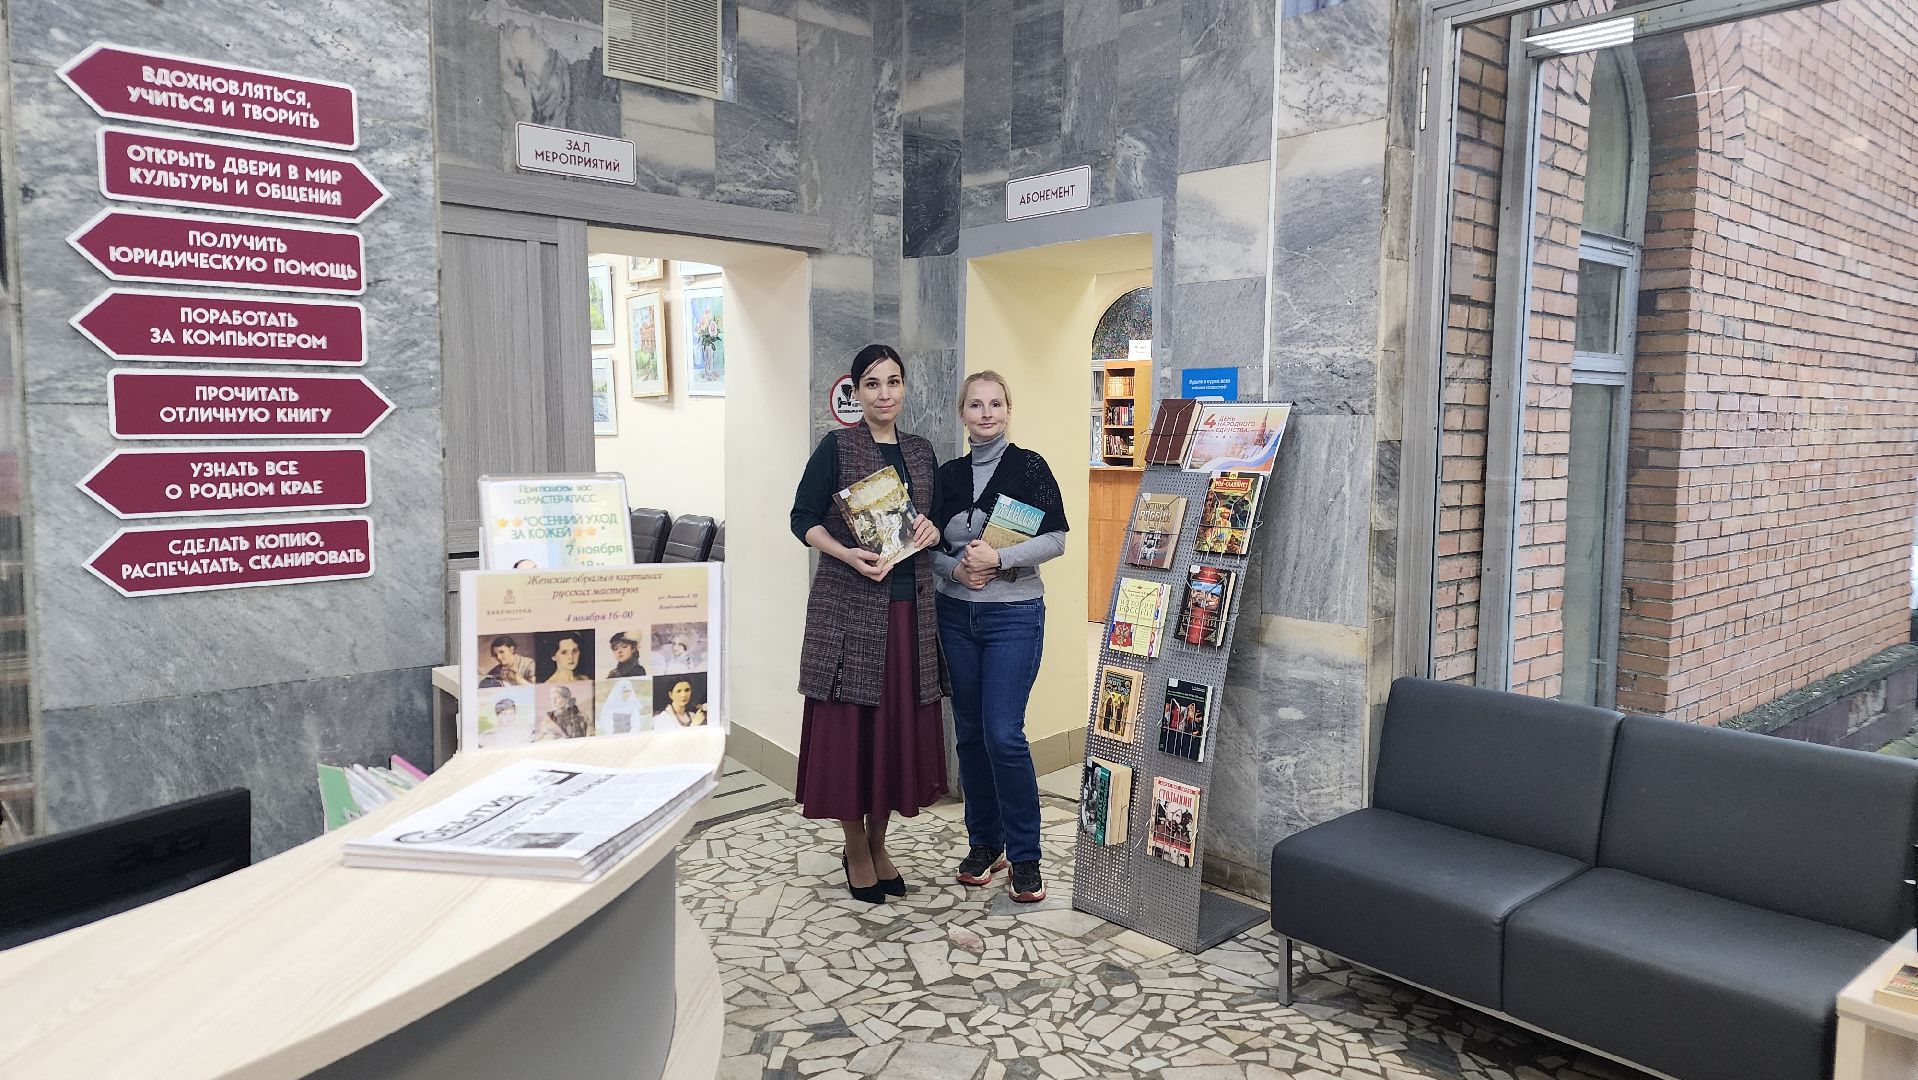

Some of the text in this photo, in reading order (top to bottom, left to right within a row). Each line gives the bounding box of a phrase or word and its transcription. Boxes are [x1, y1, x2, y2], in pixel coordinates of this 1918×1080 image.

[141, 65, 312, 109] ВДОХНОВЛЯТЬСЯ,
[126, 86, 320, 129] УЧИТЬСЯ И ТВОРИТЬ
[565, 139, 590, 153] ЗАЛ
[126, 144, 343, 186] ОТКРЫТЬ ДВЕРИ В МИР
[534, 149, 621, 173] МЕРОПРИЯТИЙ
[128, 166, 343, 206] КУЛЬТУРЫ И ОБЩЕНИЯ
[1019, 184, 1076, 206] АБОНЕМЕНТ
[187, 230, 288, 254] ПОЛУЧИТЬ
[108, 245, 358, 281] ЮРИДИЧЕСКУЮ ПОМОЩЬ
[179, 306, 299, 329] ПОРАБОТАТЬ
[149, 327, 328, 350] ЗА КОМПЬЮТЕРОМ
[194, 384, 300, 403] ПРОЧИТАТЬ
[158, 406, 333, 424] ОТЛИЧНУЮ КНИГУ
[1203, 413, 1217, 429] 4
[190, 460, 300, 478] УЗНАТЬ ВСЕ
[164, 479, 324, 500] О РОДНОМ КРАЕ
[584, 513, 618, 525] УХОД
[168, 531, 325, 557] СДЕЛАТЬ КОПИЮ,
[511, 526, 572, 540] ЗА КОЖЕЙ
[565, 544, 623, 556] 7 ноября
[121, 548, 367, 580] РАСПЕЧАТАТЬ, СКАНИРОВАТЬ
